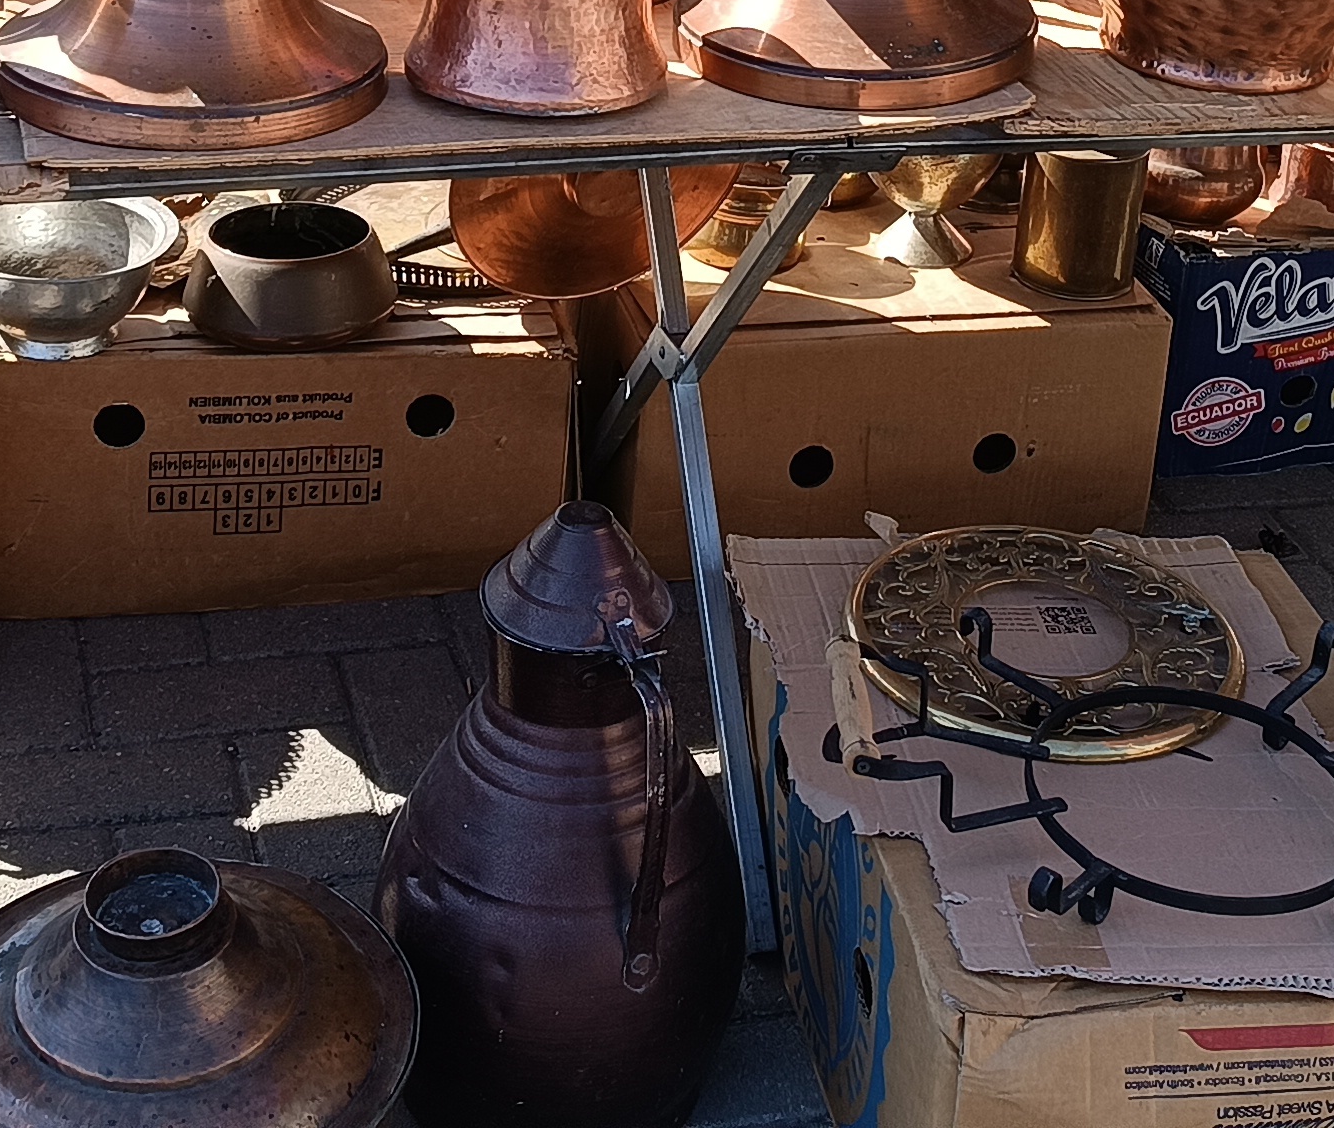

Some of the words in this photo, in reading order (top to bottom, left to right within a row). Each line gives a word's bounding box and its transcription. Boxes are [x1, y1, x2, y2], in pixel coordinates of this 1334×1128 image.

[189, 396, 271, 408] KOLUMBIEN
[276, 395, 299, 404] aus
[303, 392, 353, 404] Produkt
[275, 411, 292, 423] of
[294, 410, 343, 421] Product
[1177, 396, 1258, 429] ECUADOR
[198, 413, 273, 425] COLOMBIA
[182, 459, 193, 470] 13
[196, 459, 208, 469] 12
[211, 458, 223, 469] 11
[226, 458, 238, 468] 10
[243, 458, 250, 468] 9
[258, 458, 265, 467] 8
[272, 457, 279, 467] 7
[287, 456, 294, 466] 6
[301, 455, 308, 465] 5
[315, 455, 323, 465] 4
[329, 454, 337, 465] 3
[344, 454, 352, 464] 2
[358, 454, 366, 464] 1
[372, 449, 383, 468] E
[151, 460, 164, 471] 15
[167, 460, 179, 470] 14
[222, 489, 232, 503] 6
[244, 488, 254, 503] 5
[266, 488, 276, 502] 4
[288, 486, 297, 500] 3
[309, 485, 319, 499] 2
[332, 484, 340, 498] 1
[352, 484, 362, 498] 0
[371, 480, 381, 501] F
[156, 491, 166, 505] 9
[178, 490, 188, 504] 8
[200, 490, 210, 504] 7
[221, 514, 231, 528] 3
[243, 514, 253, 527] 2
[266, 513, 274, 527] 1
[1125, 1079, 1165, 1091] America
[1167, 1078, 1195, 1090] South
[1204, 1076, 1245, 1088] Ecuador
[1217, 1104, 1274, 1120] Passion
[1276, 1100, 1323, 1116] Sweet
